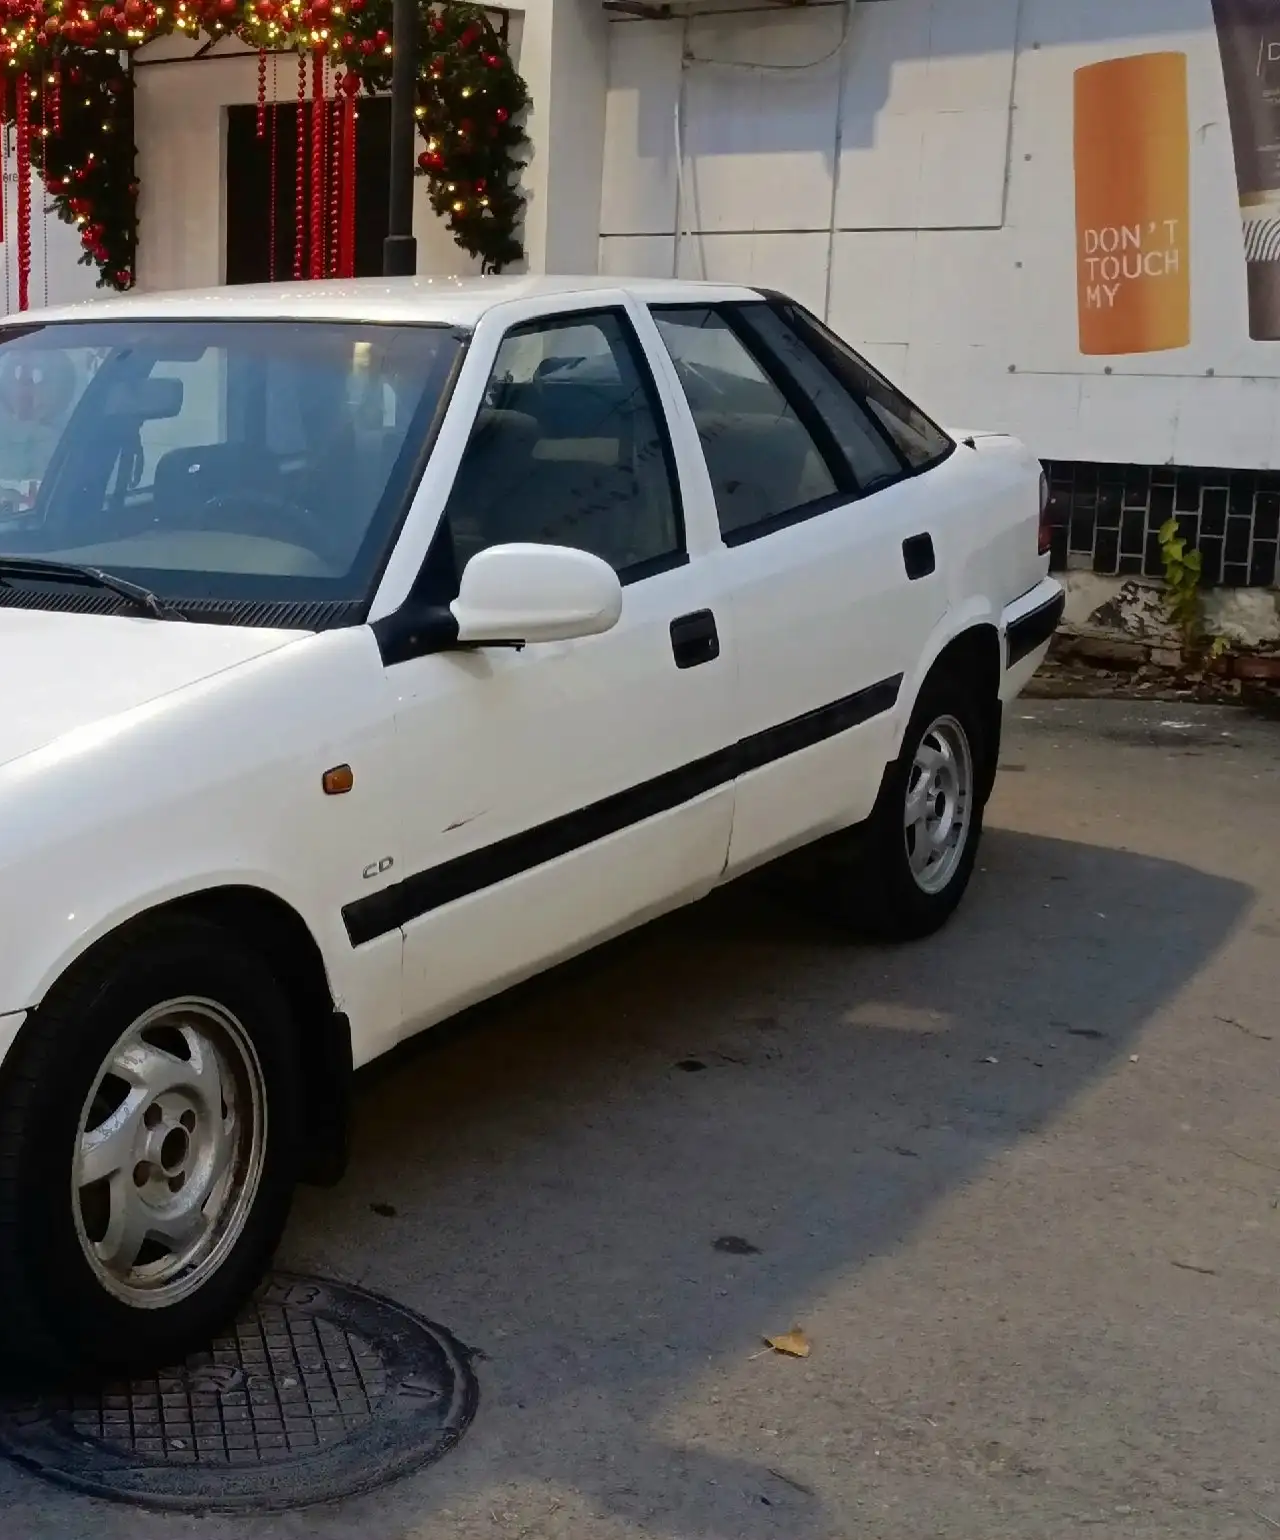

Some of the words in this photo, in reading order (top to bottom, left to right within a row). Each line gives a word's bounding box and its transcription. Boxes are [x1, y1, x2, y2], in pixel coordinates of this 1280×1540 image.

[1084, 219, 1179, 254] DON'T
[1083, 248, 1179, 281] TOUCH
[1086, 283, 1121, 309] MY
[362, 856, 394, 879] CD
